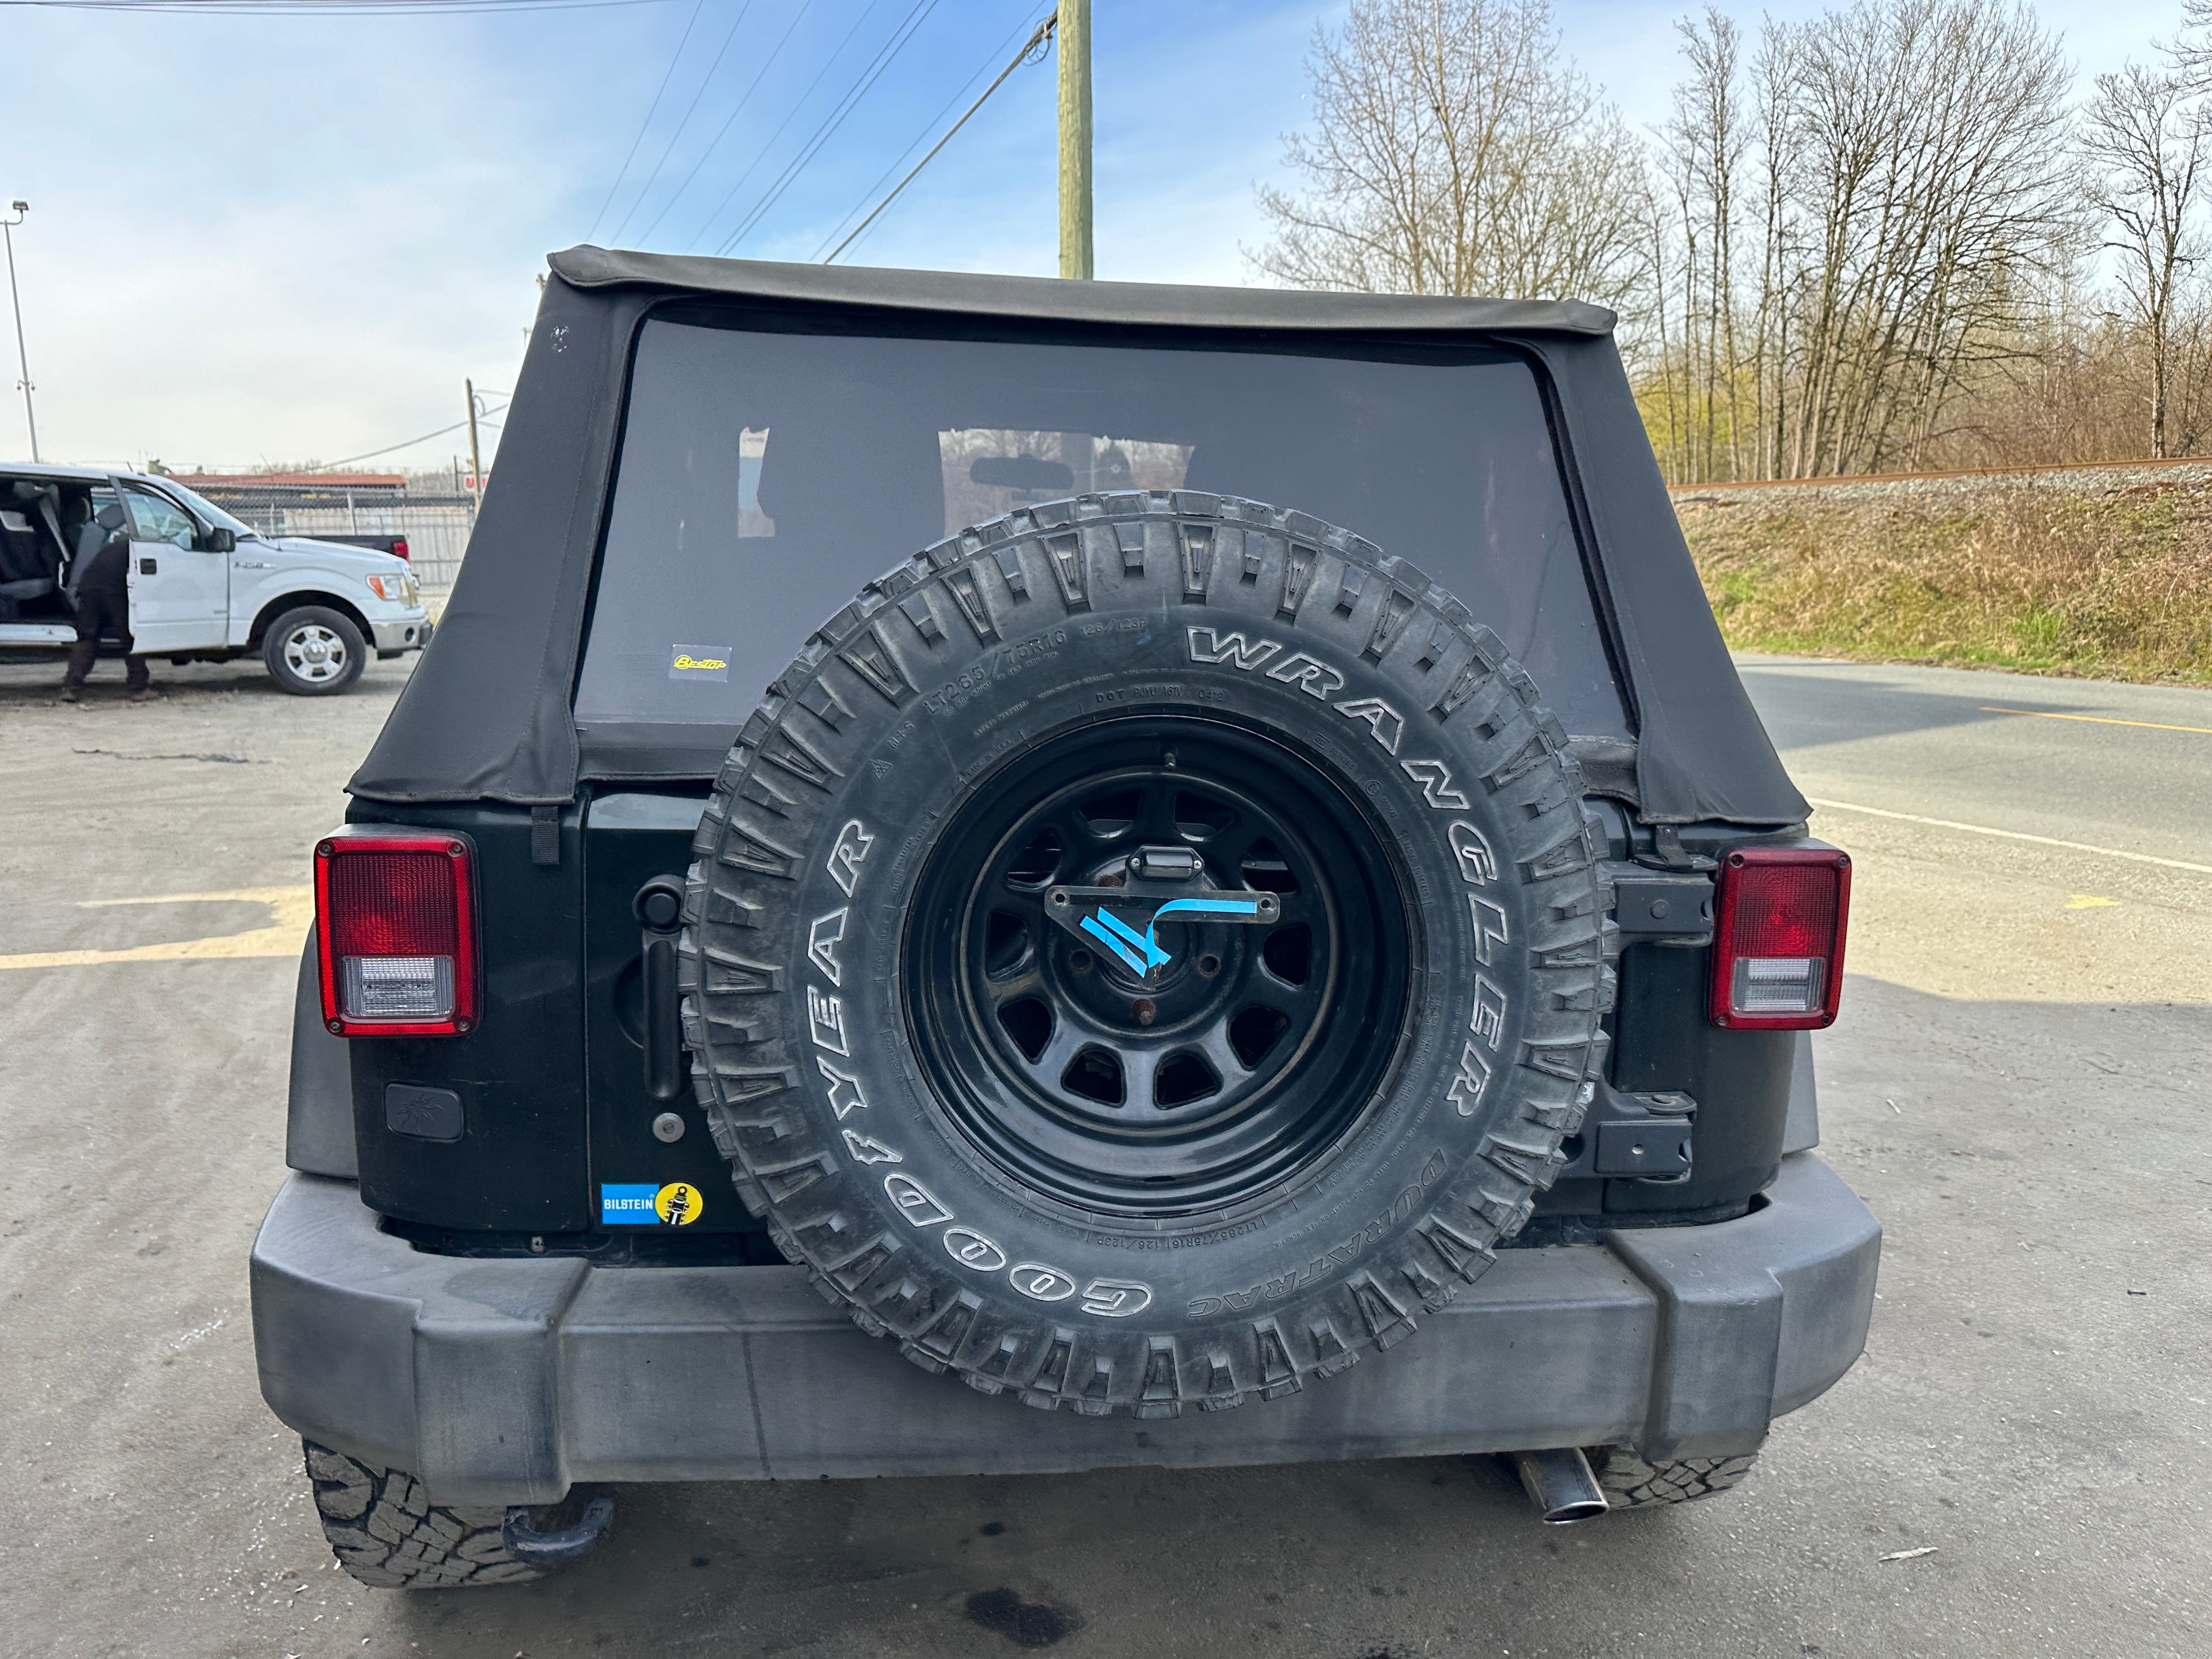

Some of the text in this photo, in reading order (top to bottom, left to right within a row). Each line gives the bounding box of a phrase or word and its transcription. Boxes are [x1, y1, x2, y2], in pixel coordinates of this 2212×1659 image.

[1094, 688, 1126, 704] DOT
[885, 718, 915, 750] M+S
[1187, 626, 1508, 1117] WRANGLER
[1414, 865, 1430, 897] TUBELESS
[807, 819, 1152, 1317] GOODYEAR
[604, 1199, 654, 1210] BILSTEIN
[1095, 1233, 1160, 1251] 126/123P
[1188, 1149, 1446, 1317] DURATRAC
